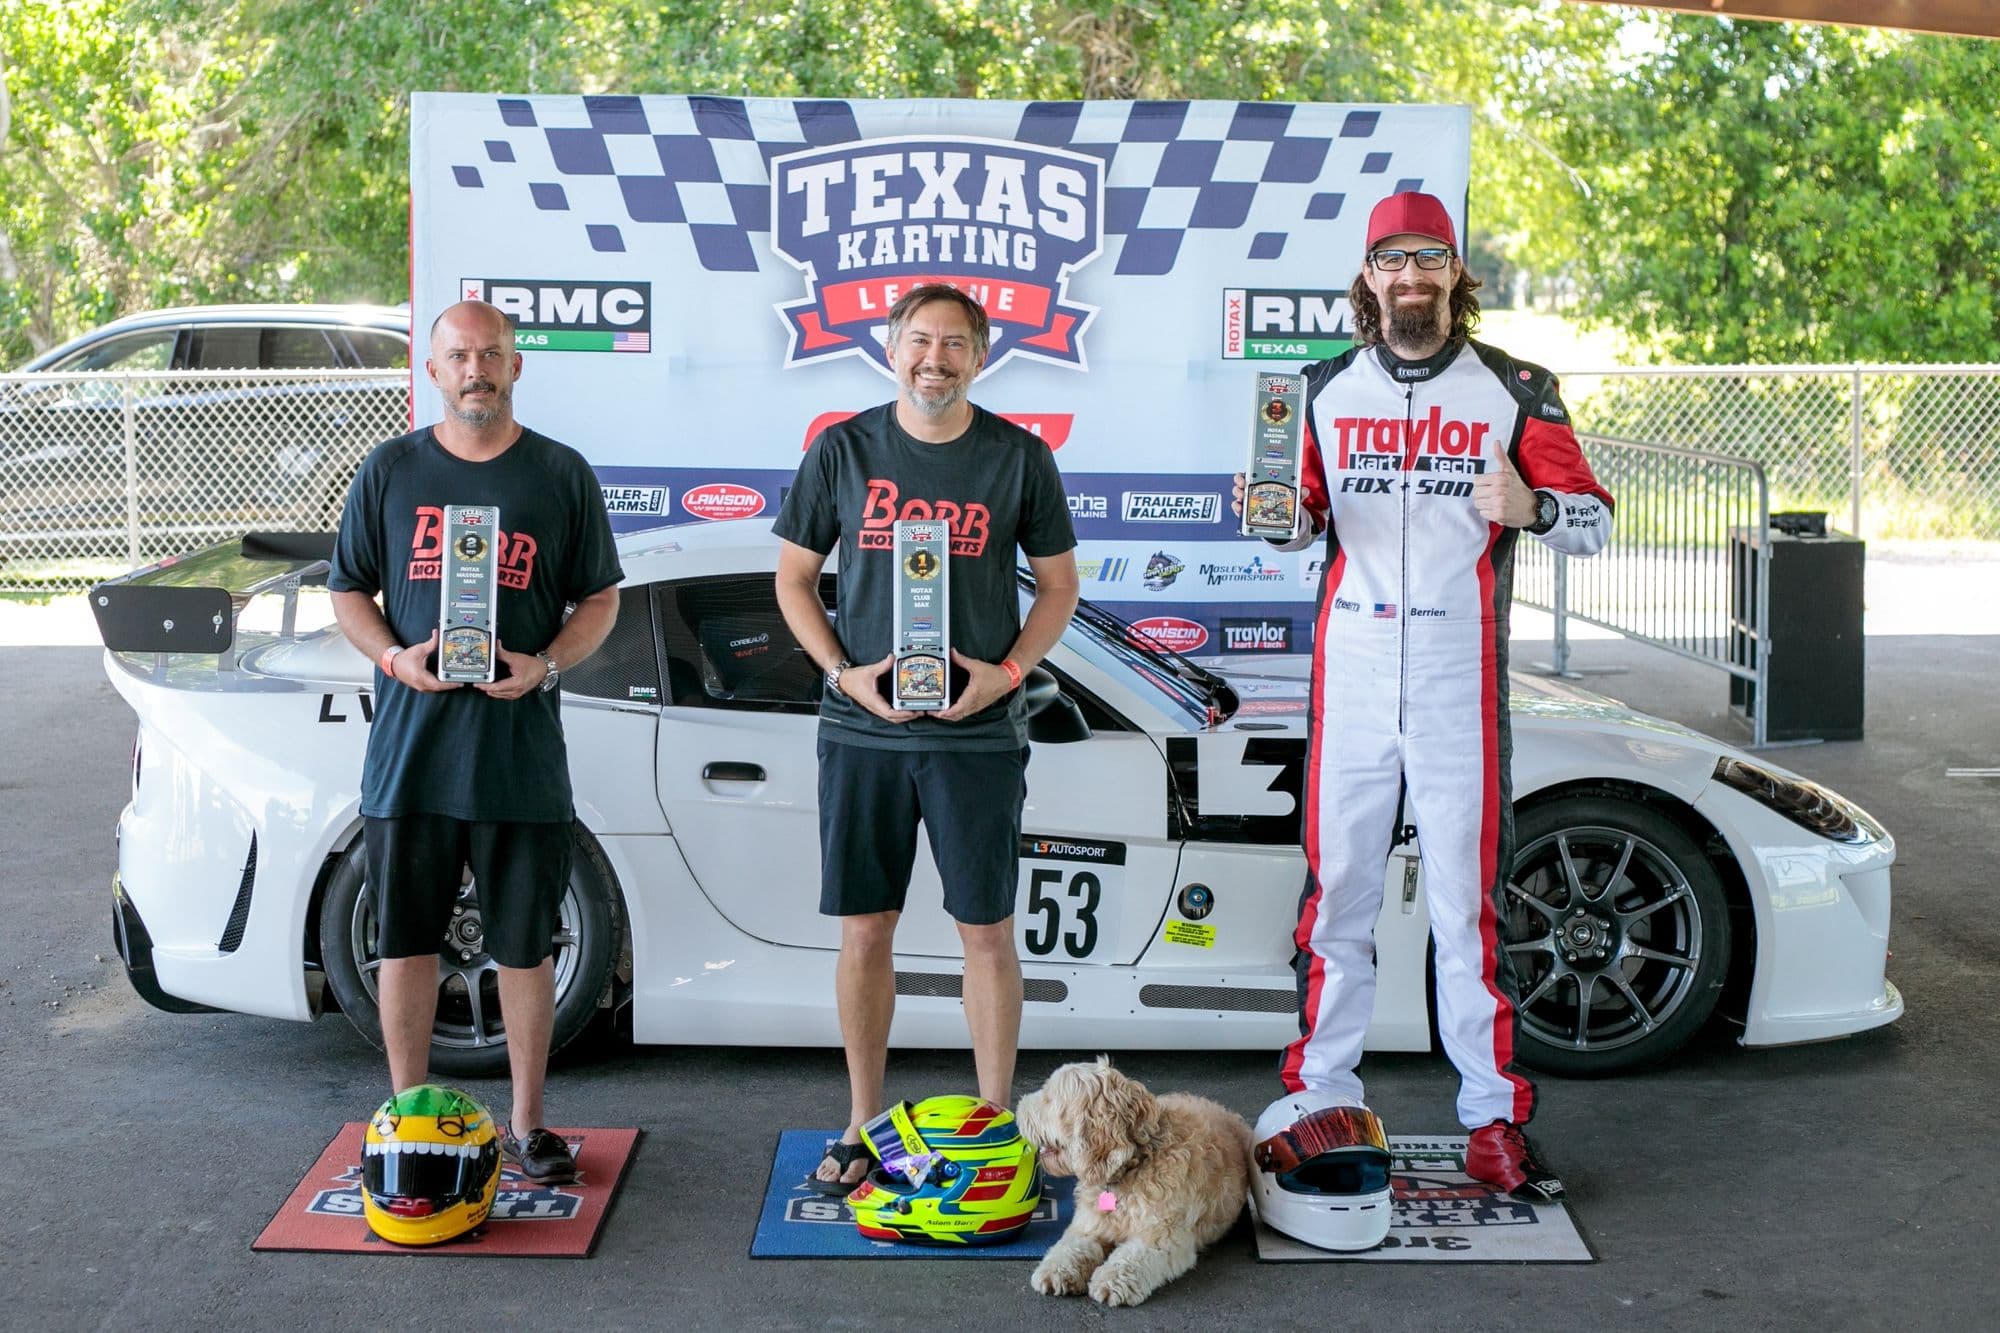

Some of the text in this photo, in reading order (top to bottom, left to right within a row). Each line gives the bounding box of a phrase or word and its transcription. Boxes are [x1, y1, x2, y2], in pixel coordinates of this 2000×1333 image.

[787, 152, 1087, 242] TEXAS
[838, 225, 1037, 271] KARTING
[859, 283, 1015, 311] LEUE
[491, 286, 645, 326] RMC
[1252, 296, 1356, 333] RM
[1228, 298, 1241, 353] ROTAX
[515, 334, 549, 345] XAS
[1251, 343, 1308, 354] TEXAS
[1396, 367, 1430, 378] freem
[1334, 406, 1490, 471] Traylor
[1355, 455, 1476, 475] kart tech
[1341, 477, 1396, 494] FOX
[1416, 479, 1475, 497] SON
[607, 500, 648, 512] ARMS
[687, 494, 758, 506] LAWSON
[1133, 496, 1201, 507] TRAILER-
[1071, 511, 1108, 519] TIMING
[1138, 508, 1200, 519] ALARMS
[466, 537, 477, 549] 2
[918, 553, 927, 567] 1
[1199, 564, 1244, 575] MOSLEY
[1207, 574, 1285, 585] MOTORSPORTS
[1410, 607, 1446, 617] Berrien
[1225, 621, 1286, 649] Traylor
[1049, 844, 1107, 858] AUTOSPORT
[1025, 868, 1101, 959] 53
